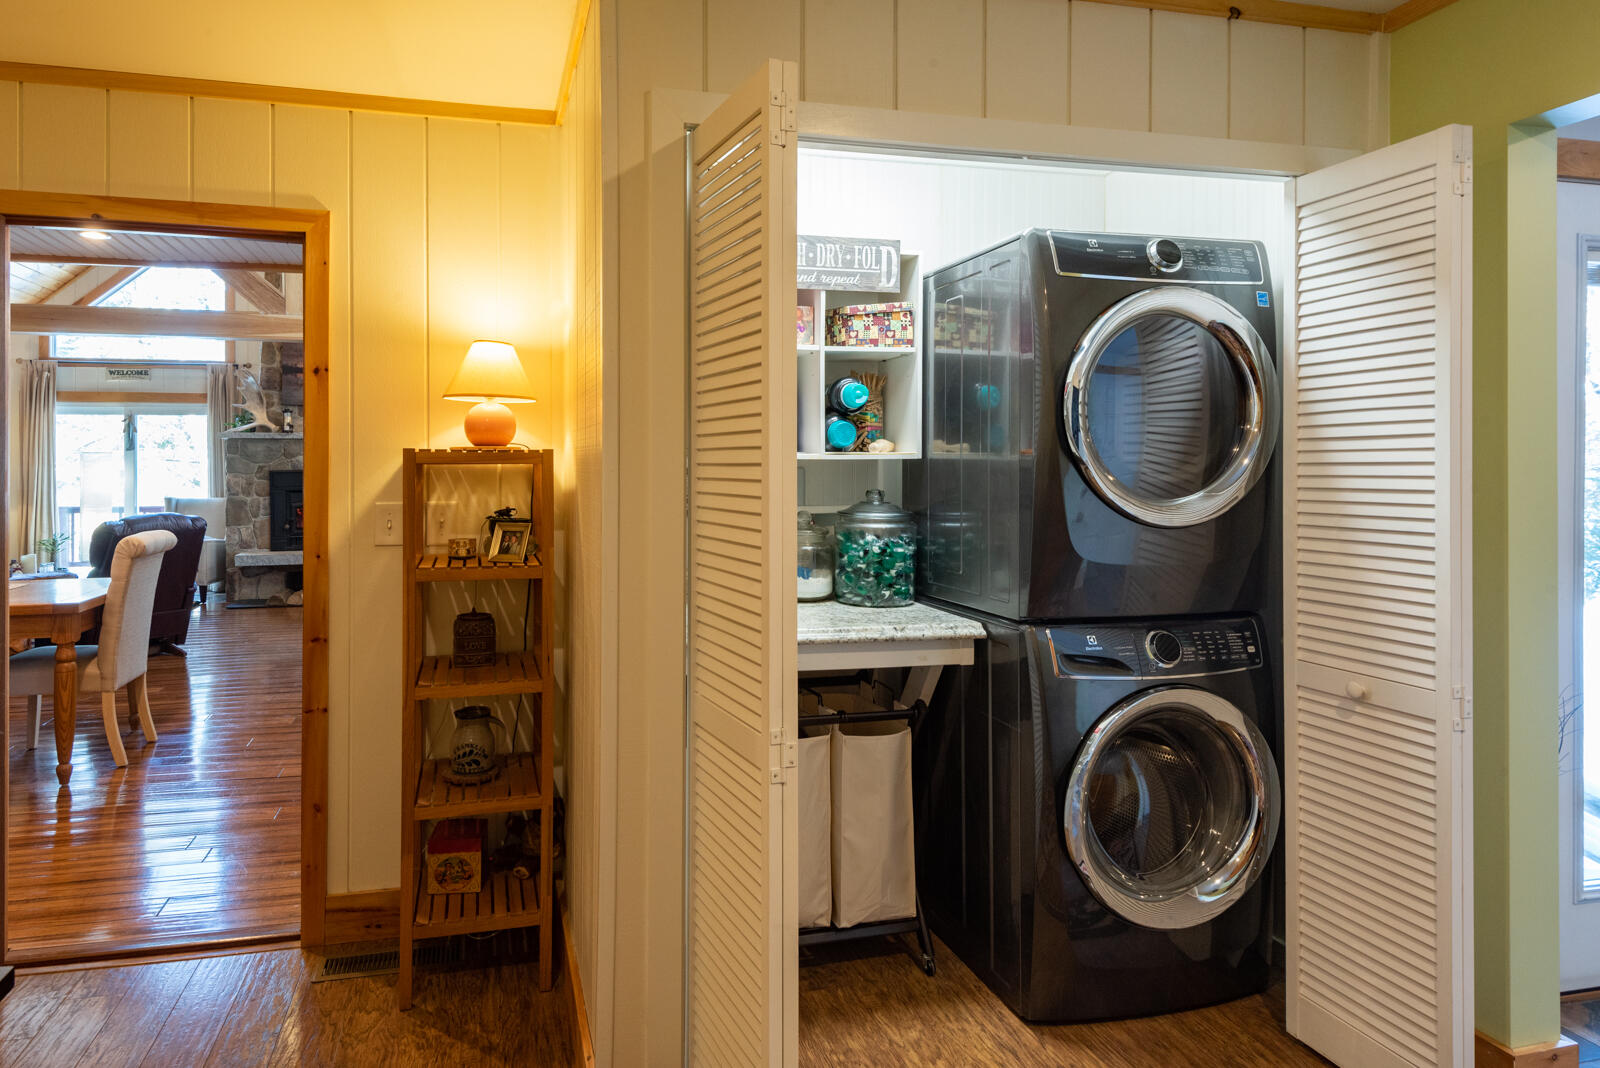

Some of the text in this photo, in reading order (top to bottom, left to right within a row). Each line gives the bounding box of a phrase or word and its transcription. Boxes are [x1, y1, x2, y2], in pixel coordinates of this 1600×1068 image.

[816, 243, 845, 268] DRY
[854, 245, 898, 288] FOLD
[820, 273, 861, 287] repeat
